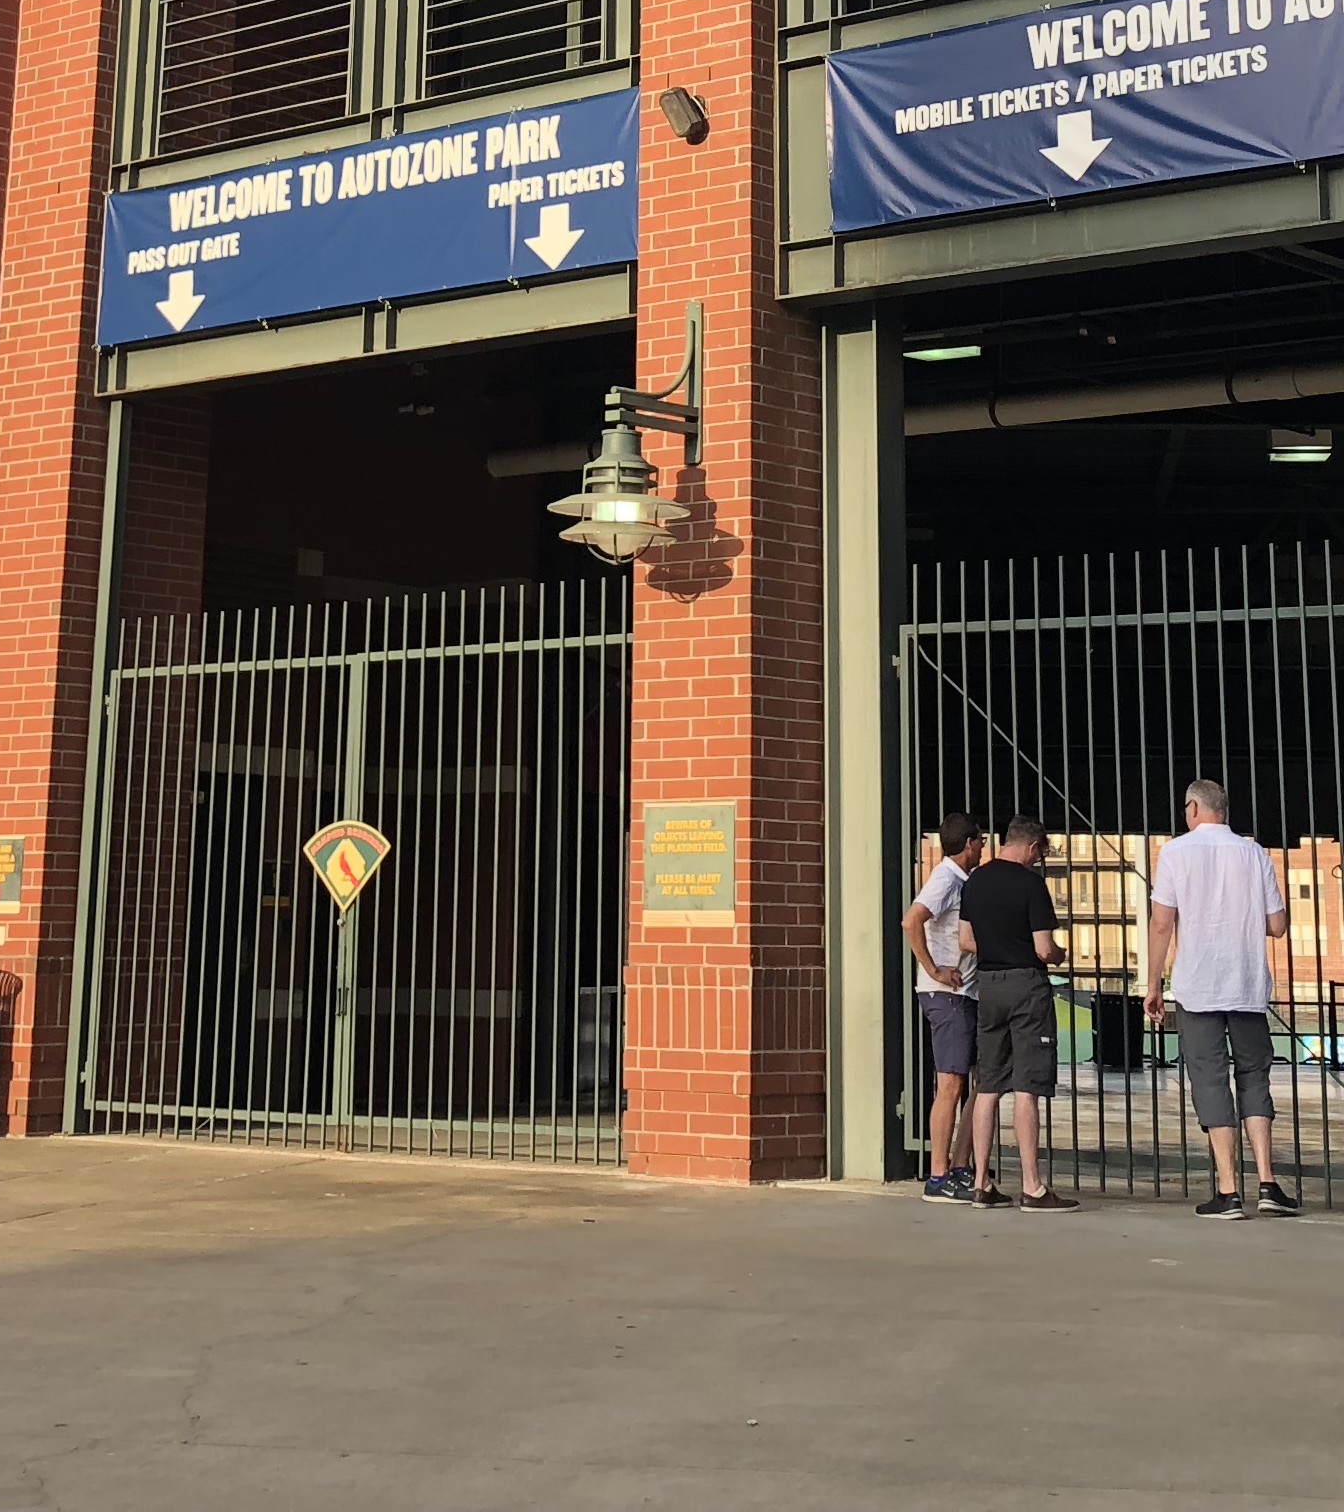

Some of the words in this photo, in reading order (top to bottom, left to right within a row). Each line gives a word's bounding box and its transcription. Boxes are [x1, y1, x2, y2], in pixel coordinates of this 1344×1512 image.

[894, 96, 974, 135] MOBILE
[978, 81, 1069, 120] TICKETS
[1074, 75, 1090, 104] /
[1092, 64, 1164, 101] PAPER
[1167, 44, 1268, 88] TICKETS
[169, 170, 292, 232] WELCOME
[300, 162, 333, 207] TO
[338, 133, 478, 199] AUTOZONE
[485, 115, 561, 171] PARK
[488, 180, 544, 209] PAPER
[547, 161, 625, 197] TICKETS
[128, 249, 165, 275] PASS
[167, 242, 200, 268] OUT
[202, 233, 240, 262] GATE
